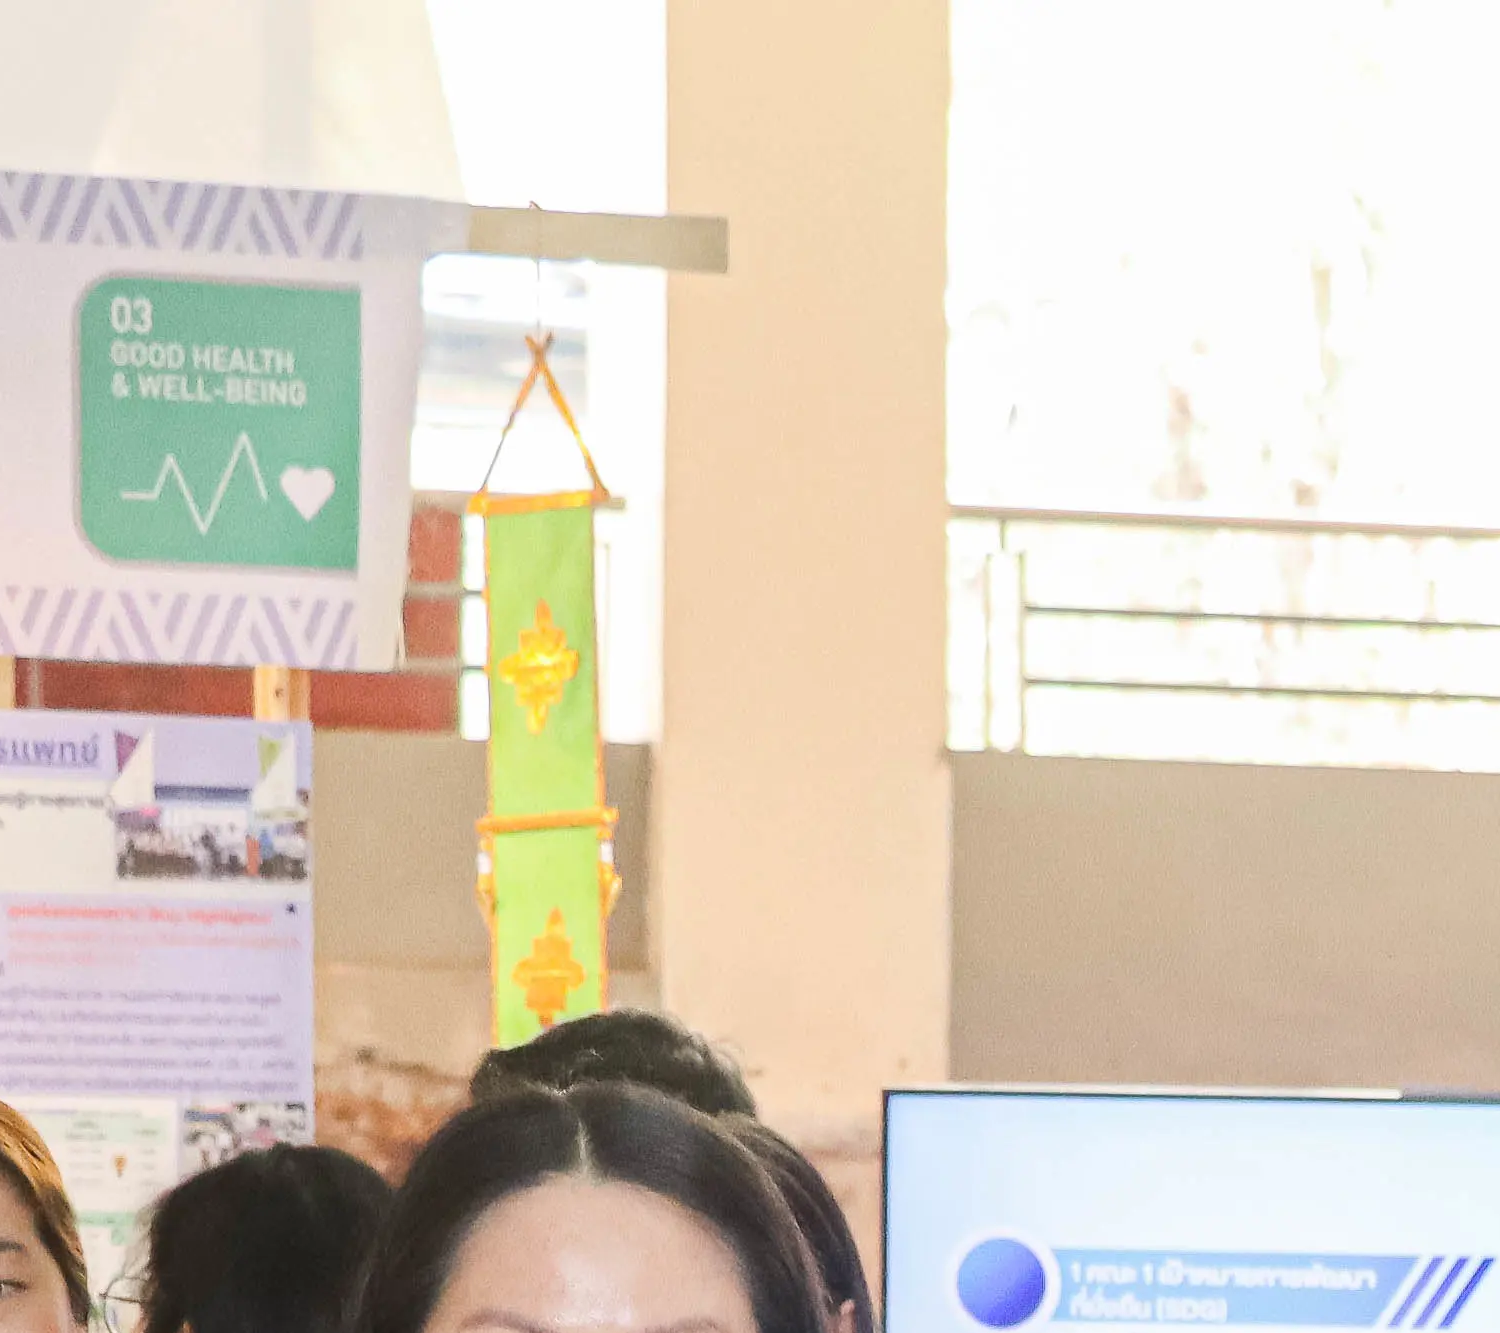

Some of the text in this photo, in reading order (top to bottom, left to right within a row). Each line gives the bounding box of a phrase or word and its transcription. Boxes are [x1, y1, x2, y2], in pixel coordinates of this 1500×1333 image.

[109, 296, 152, 335] 03
[109, 338, 296, 374] GOOD HEALTH
[110, 372, 307, 407] & WELL-BEING
